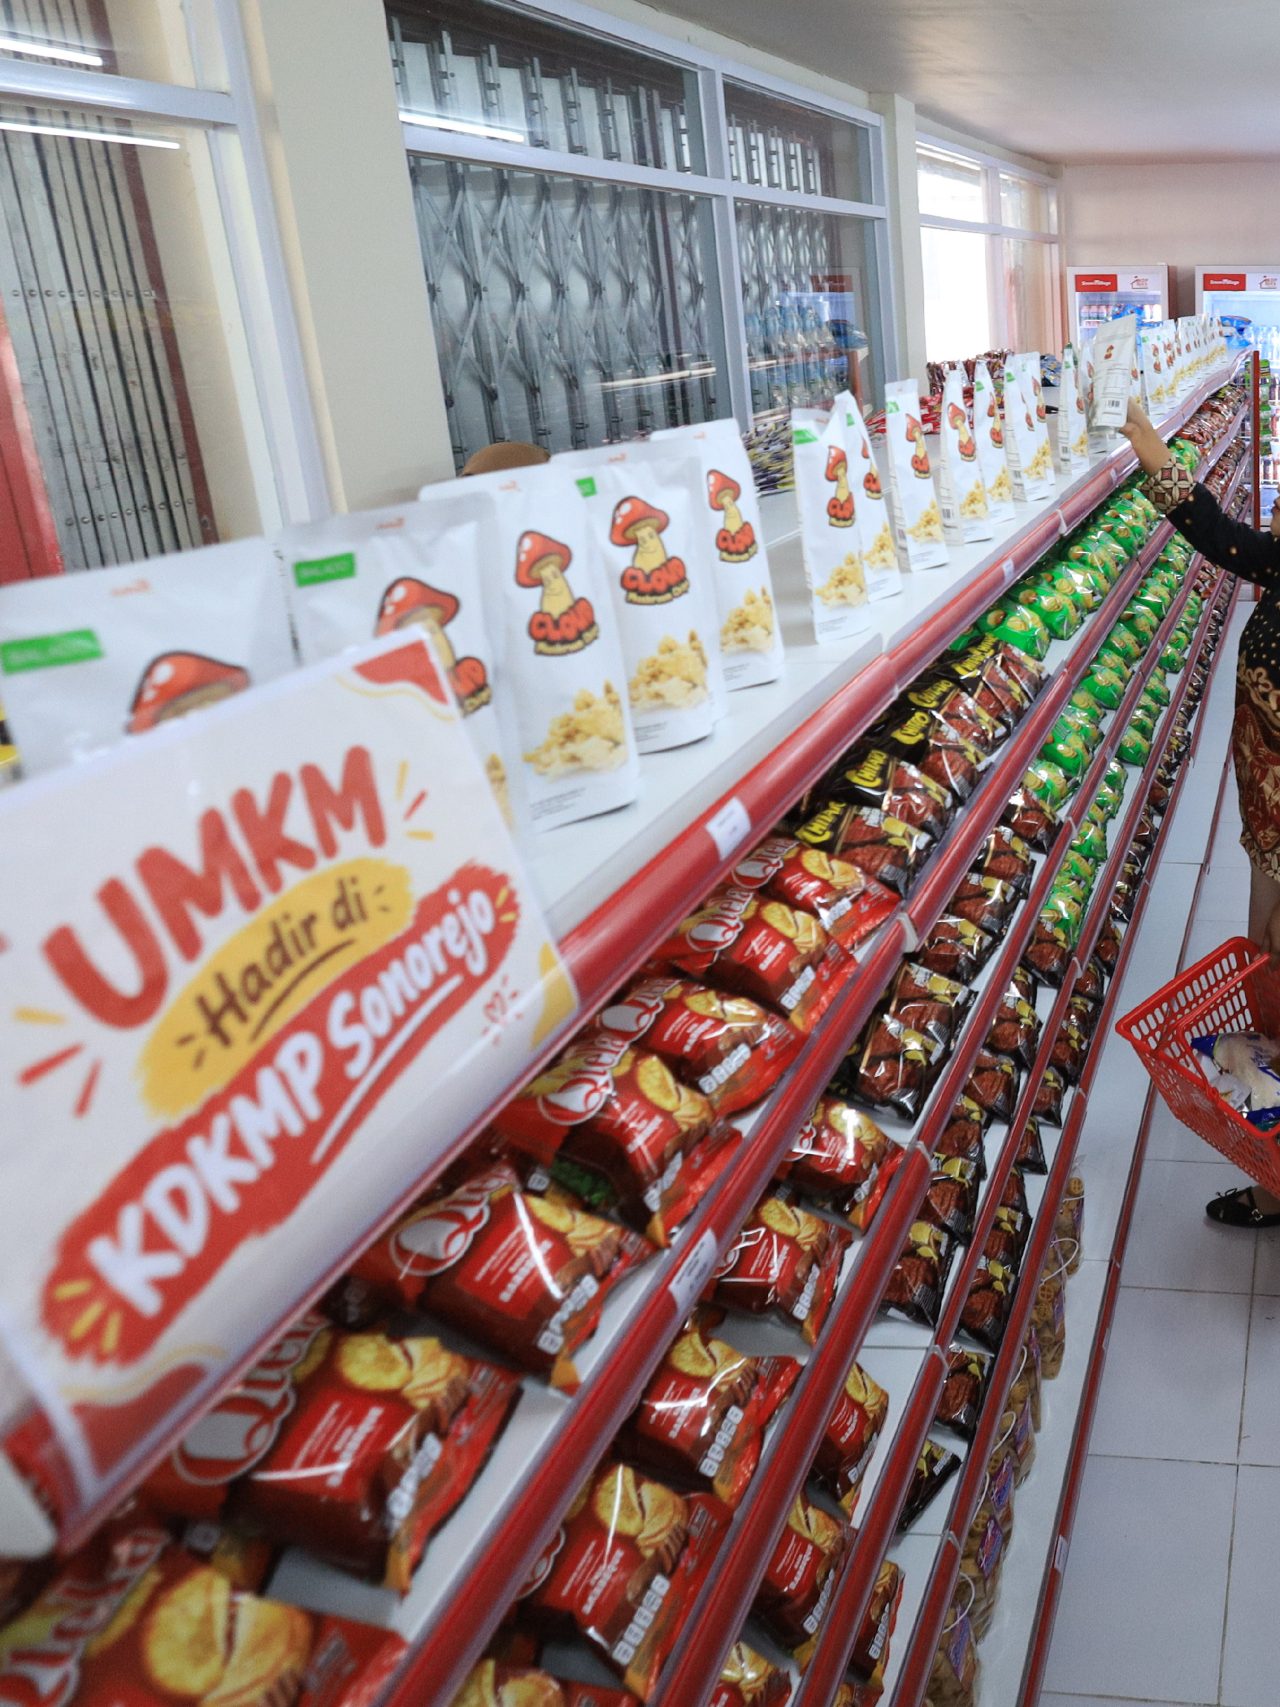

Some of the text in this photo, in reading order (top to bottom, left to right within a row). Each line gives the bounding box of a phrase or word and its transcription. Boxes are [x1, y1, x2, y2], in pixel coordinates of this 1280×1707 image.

[42, 745, 387, 1030] UMKM
[198, 876, 370, 1050] Hadir di
[686, 888, 756, 952] Qtela
[86, 886, 497, 1318] KDKMP Sonorejo
[536, 1036, 633, 1126] Qtela
